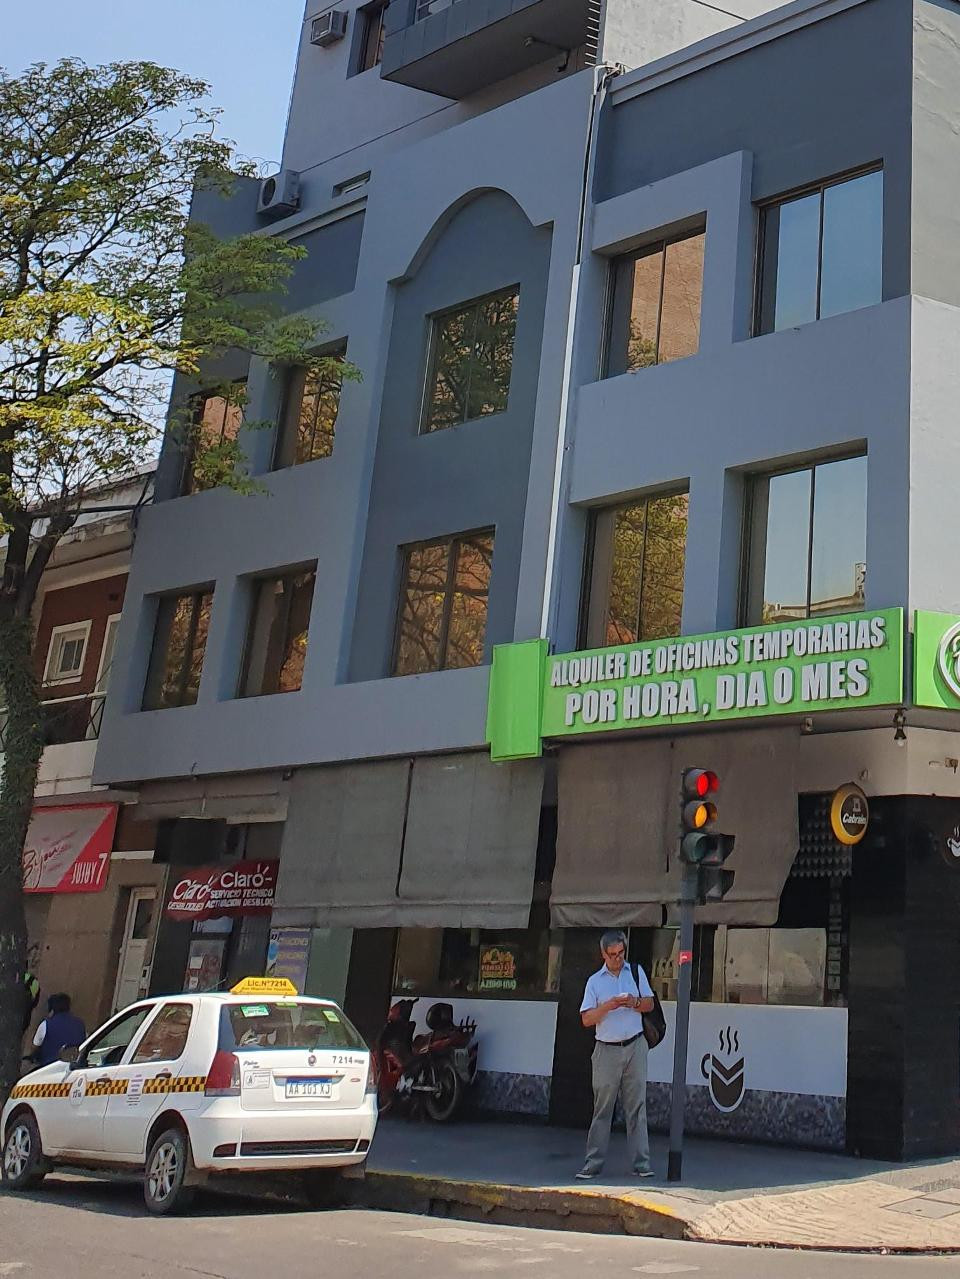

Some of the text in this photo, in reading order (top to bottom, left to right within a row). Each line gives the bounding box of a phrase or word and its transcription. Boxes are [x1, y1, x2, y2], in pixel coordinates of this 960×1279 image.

[551, 617, 886, 687] ALQUILER DE OFICINAS TEMPORARIAS
[564, 688, 617, 725] POR
[716, 670, 767, 710] DIA
[773, 666, 794, 705] O
[801, 658, 870, 701] MES
[95, 852, 108, 885] 7
[220, 870, 264, 889] Claro
[242, 888, 273, 898] TECNICO
[332, 1055, 353, 1064] 7214
[288, 1084, 299, 1095] AA
[320, 1084, 331, 1095] XJ
